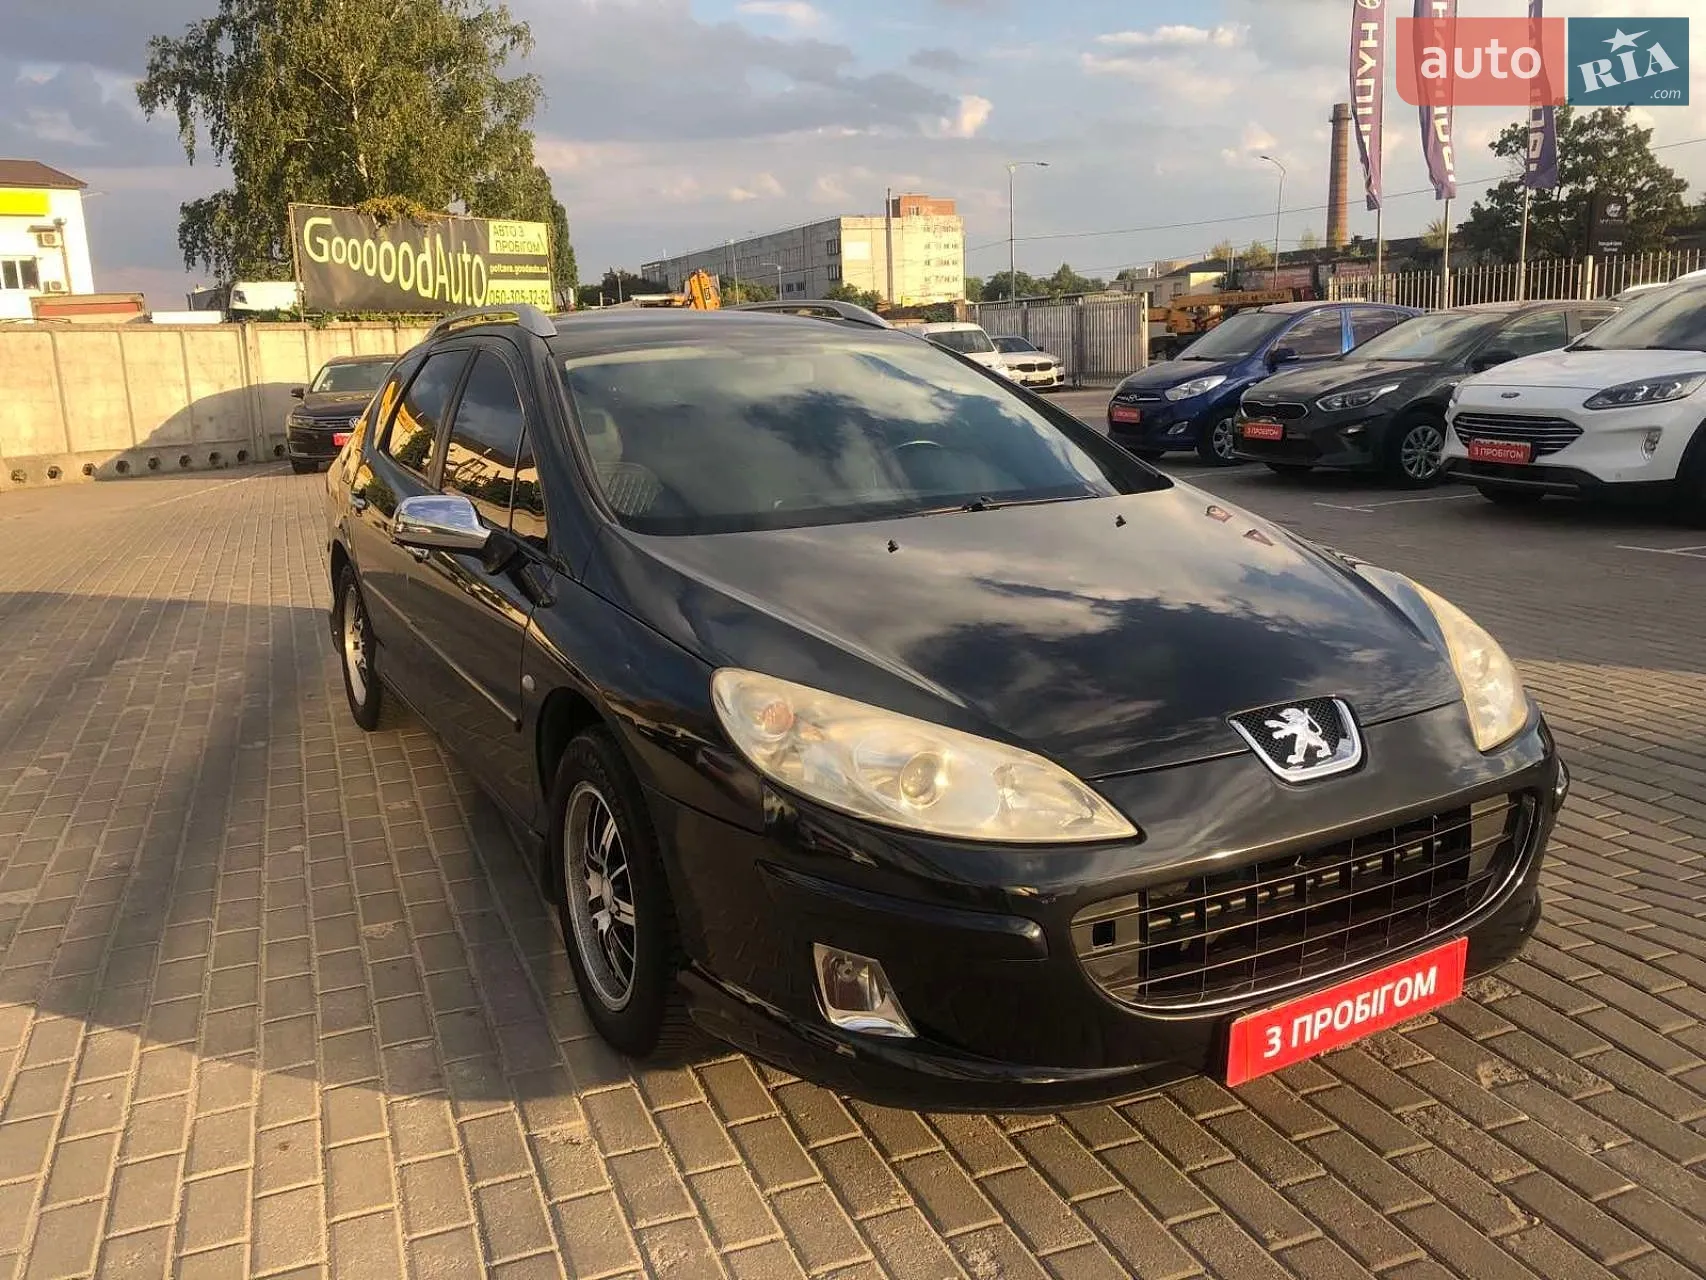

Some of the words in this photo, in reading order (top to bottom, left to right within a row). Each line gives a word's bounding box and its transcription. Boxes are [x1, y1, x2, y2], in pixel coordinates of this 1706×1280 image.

[493, 224, 517, 237] АВТО
[1480, 447, 1524, 459] ПРОБІГОМ
[1263, 1025, 1283, 1058] З
[1291, 965, 1438, 1048] ПРОБІГОМ
